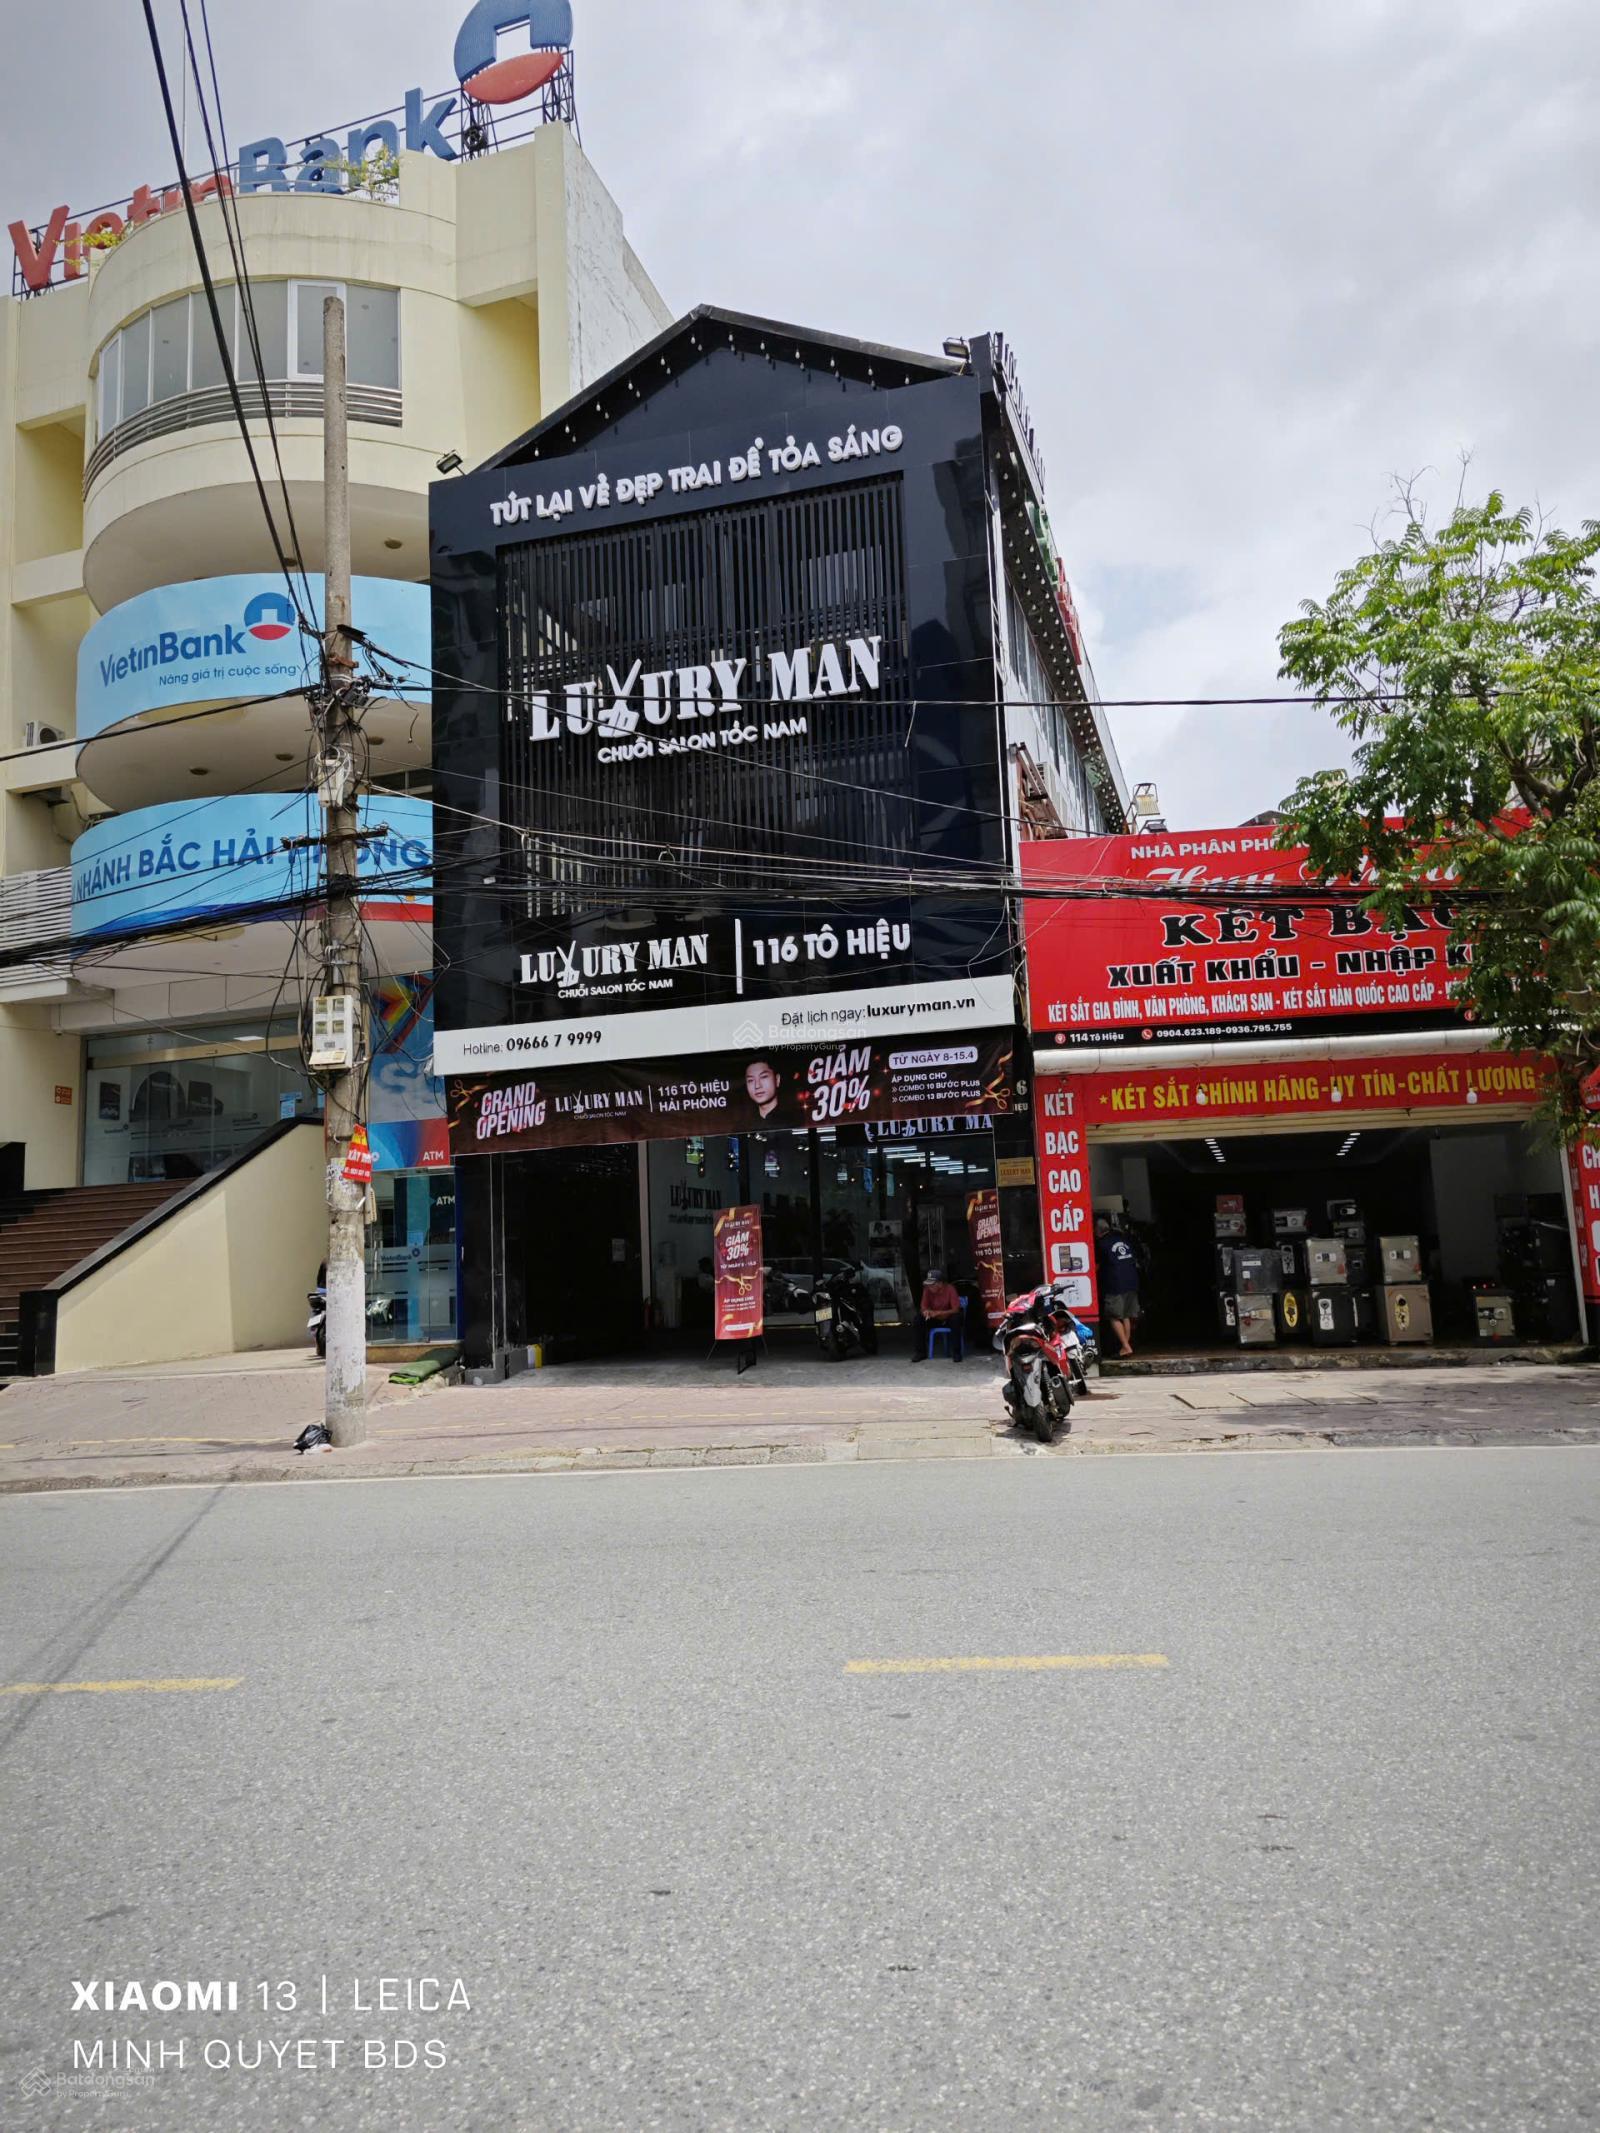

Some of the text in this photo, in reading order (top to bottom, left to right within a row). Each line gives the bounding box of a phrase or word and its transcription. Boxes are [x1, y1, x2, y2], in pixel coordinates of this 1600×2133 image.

[536, 488, 573, 521] LẠI
[578, 473, 610, 509] VẺ
[616, 472, 663, 504] ĐẸP
[668, 460, 722, 492] TRAI
[728, 437, 764, 481] ĐỂ
[768, 435, 821, 473] TỎA
[828, 424, 903, 462] SÁNG
[100, 624, 246, 687] VietinBank
[192, 670, 210, 680] giá
[214, 668, 225, 680] trị
[228, 666, 260, 678] cuộc
[265, 662, 297, 677] sống
[529, 635, 882, 741] LUXURY MAN
[658, 732, 716, 755] SALON
[720, 720, 758, 746] TÓC
[763, 717, 807, 740] NAM
[1131, 842, 1175, 859] NHÀ
[1180, 838, 1236, 856] PHÂN
[76, 853, 131, 902] NHÁNH
[138, 833, 201, 877] BẮC
[213, 828, 273, 869] HẢI
[753, 918, 911, 965] 116 TÔ HIỆU
[520, 934, 709, 987] LUXURY MAN
[1107, 956, 1196, 989] XUẤT
[1205, 949, 1300, 984] KHẨU
[1337, 945, 1435, 976] NHẬP
[590, 984, 622, 996] SALON
[625, 979, 646, 991] TÓC
[649, 978, 673, 990] NAM
[1048, 1001, 1067, 1023] KÉT
[1070, 996, 1089, 1022] SẮT
[1092, 1001, 1112, 1020] GIA
[1113, 997, 1142, 1019] ĐÌNH,
[1144, 995, 1167, 1017] VĂN
[1169, 992, 1209, 1016] PHÒNG,
[1211, 990, 1248, 1013] KHÁCH
[1250, 992, 1273, 1015] SẠN
[1283, 987, 1303, 1009] KÉT
[1306, 983, 1327, 1008] SẮT
[1329, 984, 1353, 1007] HÀN
[1355, 980, 1385, 1006] QUỐC
[1387, 985, 1409, 1003] CAO
[1412, 976, 1435, 1002] CẤP
[782, 1012, 803, 1027] Đặt
[807, 1010, 828, 1025] lịch
[867, 997, 975, 1017] luxuryman.vn
[464, 1030, 602, 1056] Hotline: 09666 7 9999
[1070, 1032, 1124, 1042] 114 Tô Hiệu
[807, 1045, 872, 1085] GIẢM
[892, 1051, 974, 1066] TỪ NGÀY 8-15.4
[658, 1079, 730, 1097] 116 TÔ HIỆU
[891, 1072, 947, 1083] ÁP DỤNG CHO
[898, 1084, 925, 1092] COMBO
[960, 1080, 981, 1088] PLUS
[1111, 1082, 1147, 1110] KÉT
[1153, 1076, 1190, 1108] SẮT
[1197, 1077, 1258, 1104] CHÍNH
[1466, 1066, 1536, 1096] LƯỢNG
[481, 1081, 536, 1116] GRAND
[555, 1090, 643, 1113] LUXURY MAN
[659, 1096, 727, 1112] HẢI PHÒNG
[811, 1075, 870, 1122] 30%
[898, 1094, 925, 1103] COMBO
[961, 1090, 981, 1098] PLUS
[1013, 1101, 1029, 1112] IỆU
[1044, 1088, 1074, 1116] KÉT
[476, 1100, 546, 1140] OPENING
[423, 1150, 444, 1161] ATM
[1044, 1130, 1079, 1159] BẠC
[1048, 1168, 1081, 1193] CAO
[436, 1195, 456, 1206] ATM
[1050, 1200, 1084, 1233] CẤP
[725, 1230, 749, 1247] GIẢM
[726, 1243, 749, 1261] 30%
